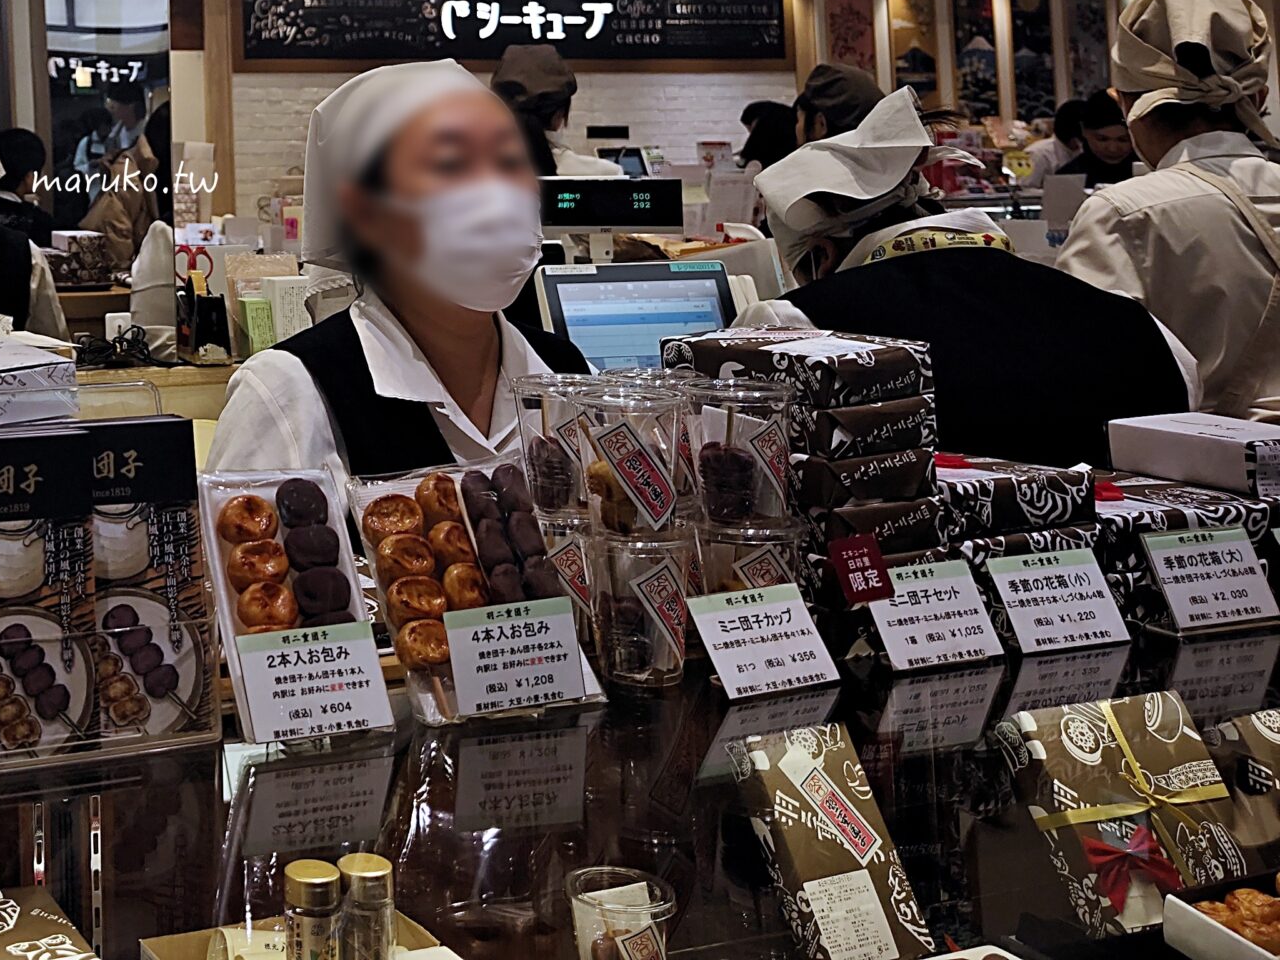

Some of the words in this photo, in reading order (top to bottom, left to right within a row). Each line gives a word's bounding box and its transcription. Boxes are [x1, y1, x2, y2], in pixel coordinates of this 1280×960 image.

[93, 450, 143, 479] 団子
[842, 547, 869, 559] エキュート
[1163, 548, 1243, 571] 季節の花箱(大)
[848, 569, 883, 592] 限定
[1008, 572, 1091, 595] 季節の花箱(小)
[888, 586, 960, 607] ミニ団子セット
[718, 607, 792, 633] ミニ団子カップ
[1034, 617, 1054, 628] (税込)
[471, 620, 550, 644] 4本入お包み
[926, 631, 946, 643] (税込)
[949, 624, 984, 639] ¥1,025
[267, 646, 350, 669] 2本入お包み
[764, 657, 786, 670] (税込)
[788, 650, 817, 663] ¥356
[486, 682, 508, 695] (税込)
[515, 674, 554, 689] ¥1,208
[289, 708, 312, 721] (税込)
[320, 701, 352, 715] ¥604
